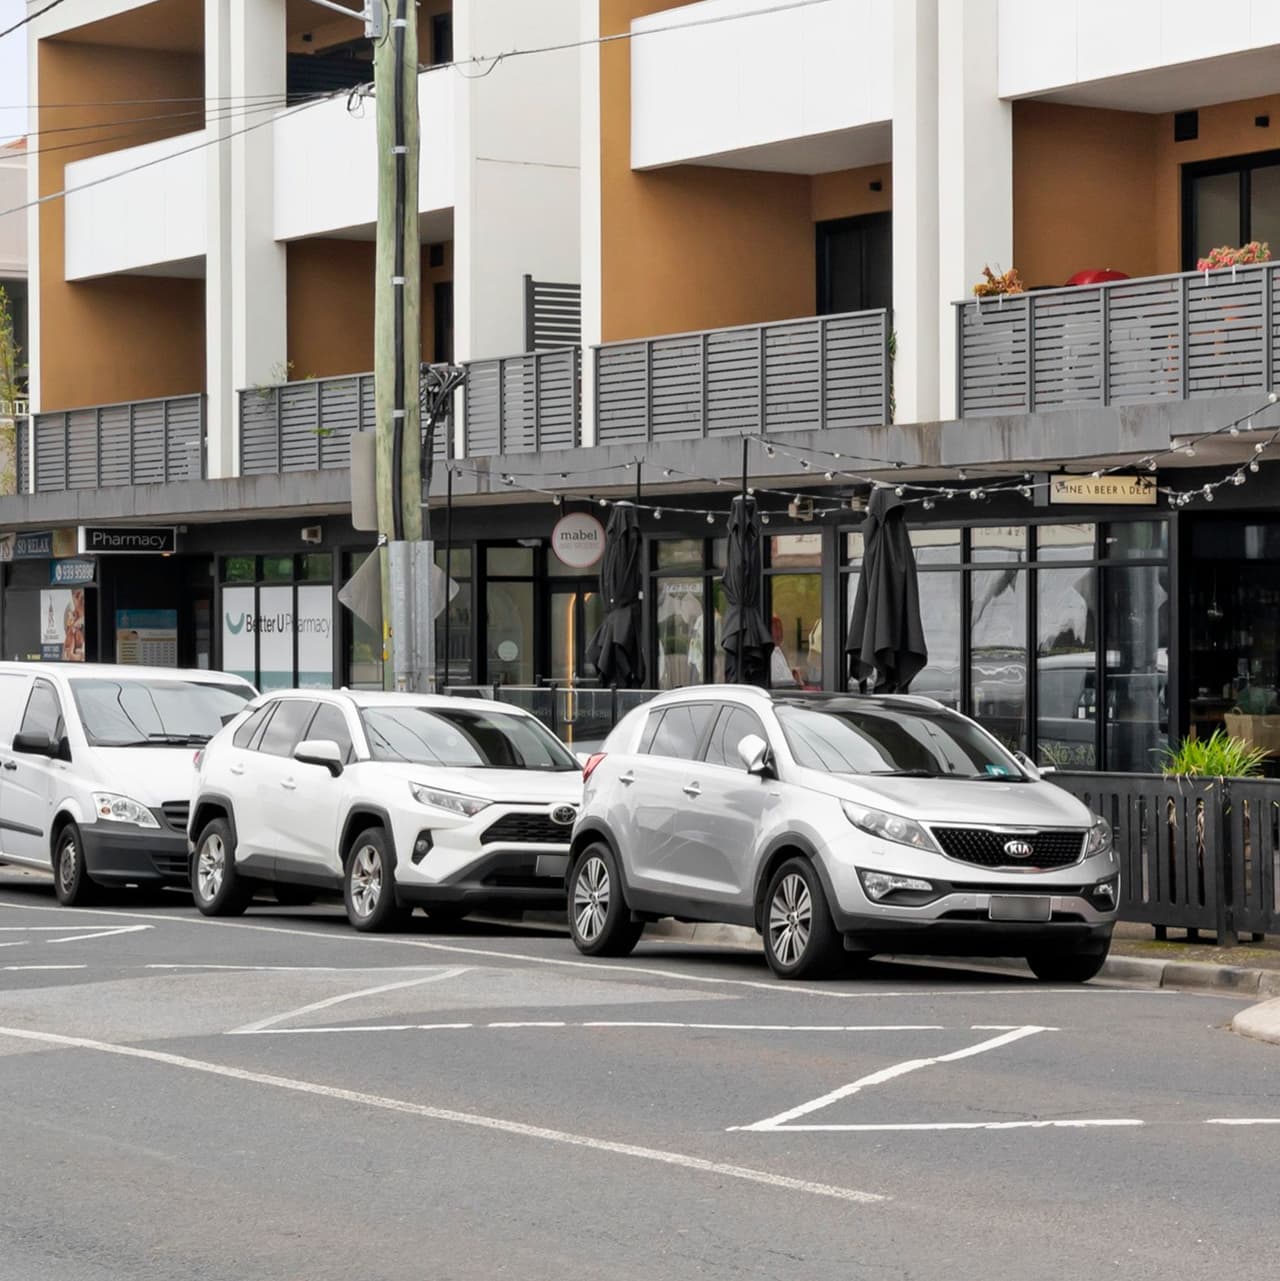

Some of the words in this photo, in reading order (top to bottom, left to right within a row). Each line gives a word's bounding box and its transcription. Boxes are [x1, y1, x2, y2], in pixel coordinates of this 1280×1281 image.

[1094, 485, 1118, 495] BEER
[92, 531, 167, 549] Pharmacy
[560, 529, 598, 541] mabel
[277, 613, 285, 633] U
[285, 613, 331, 639] Parmacy
